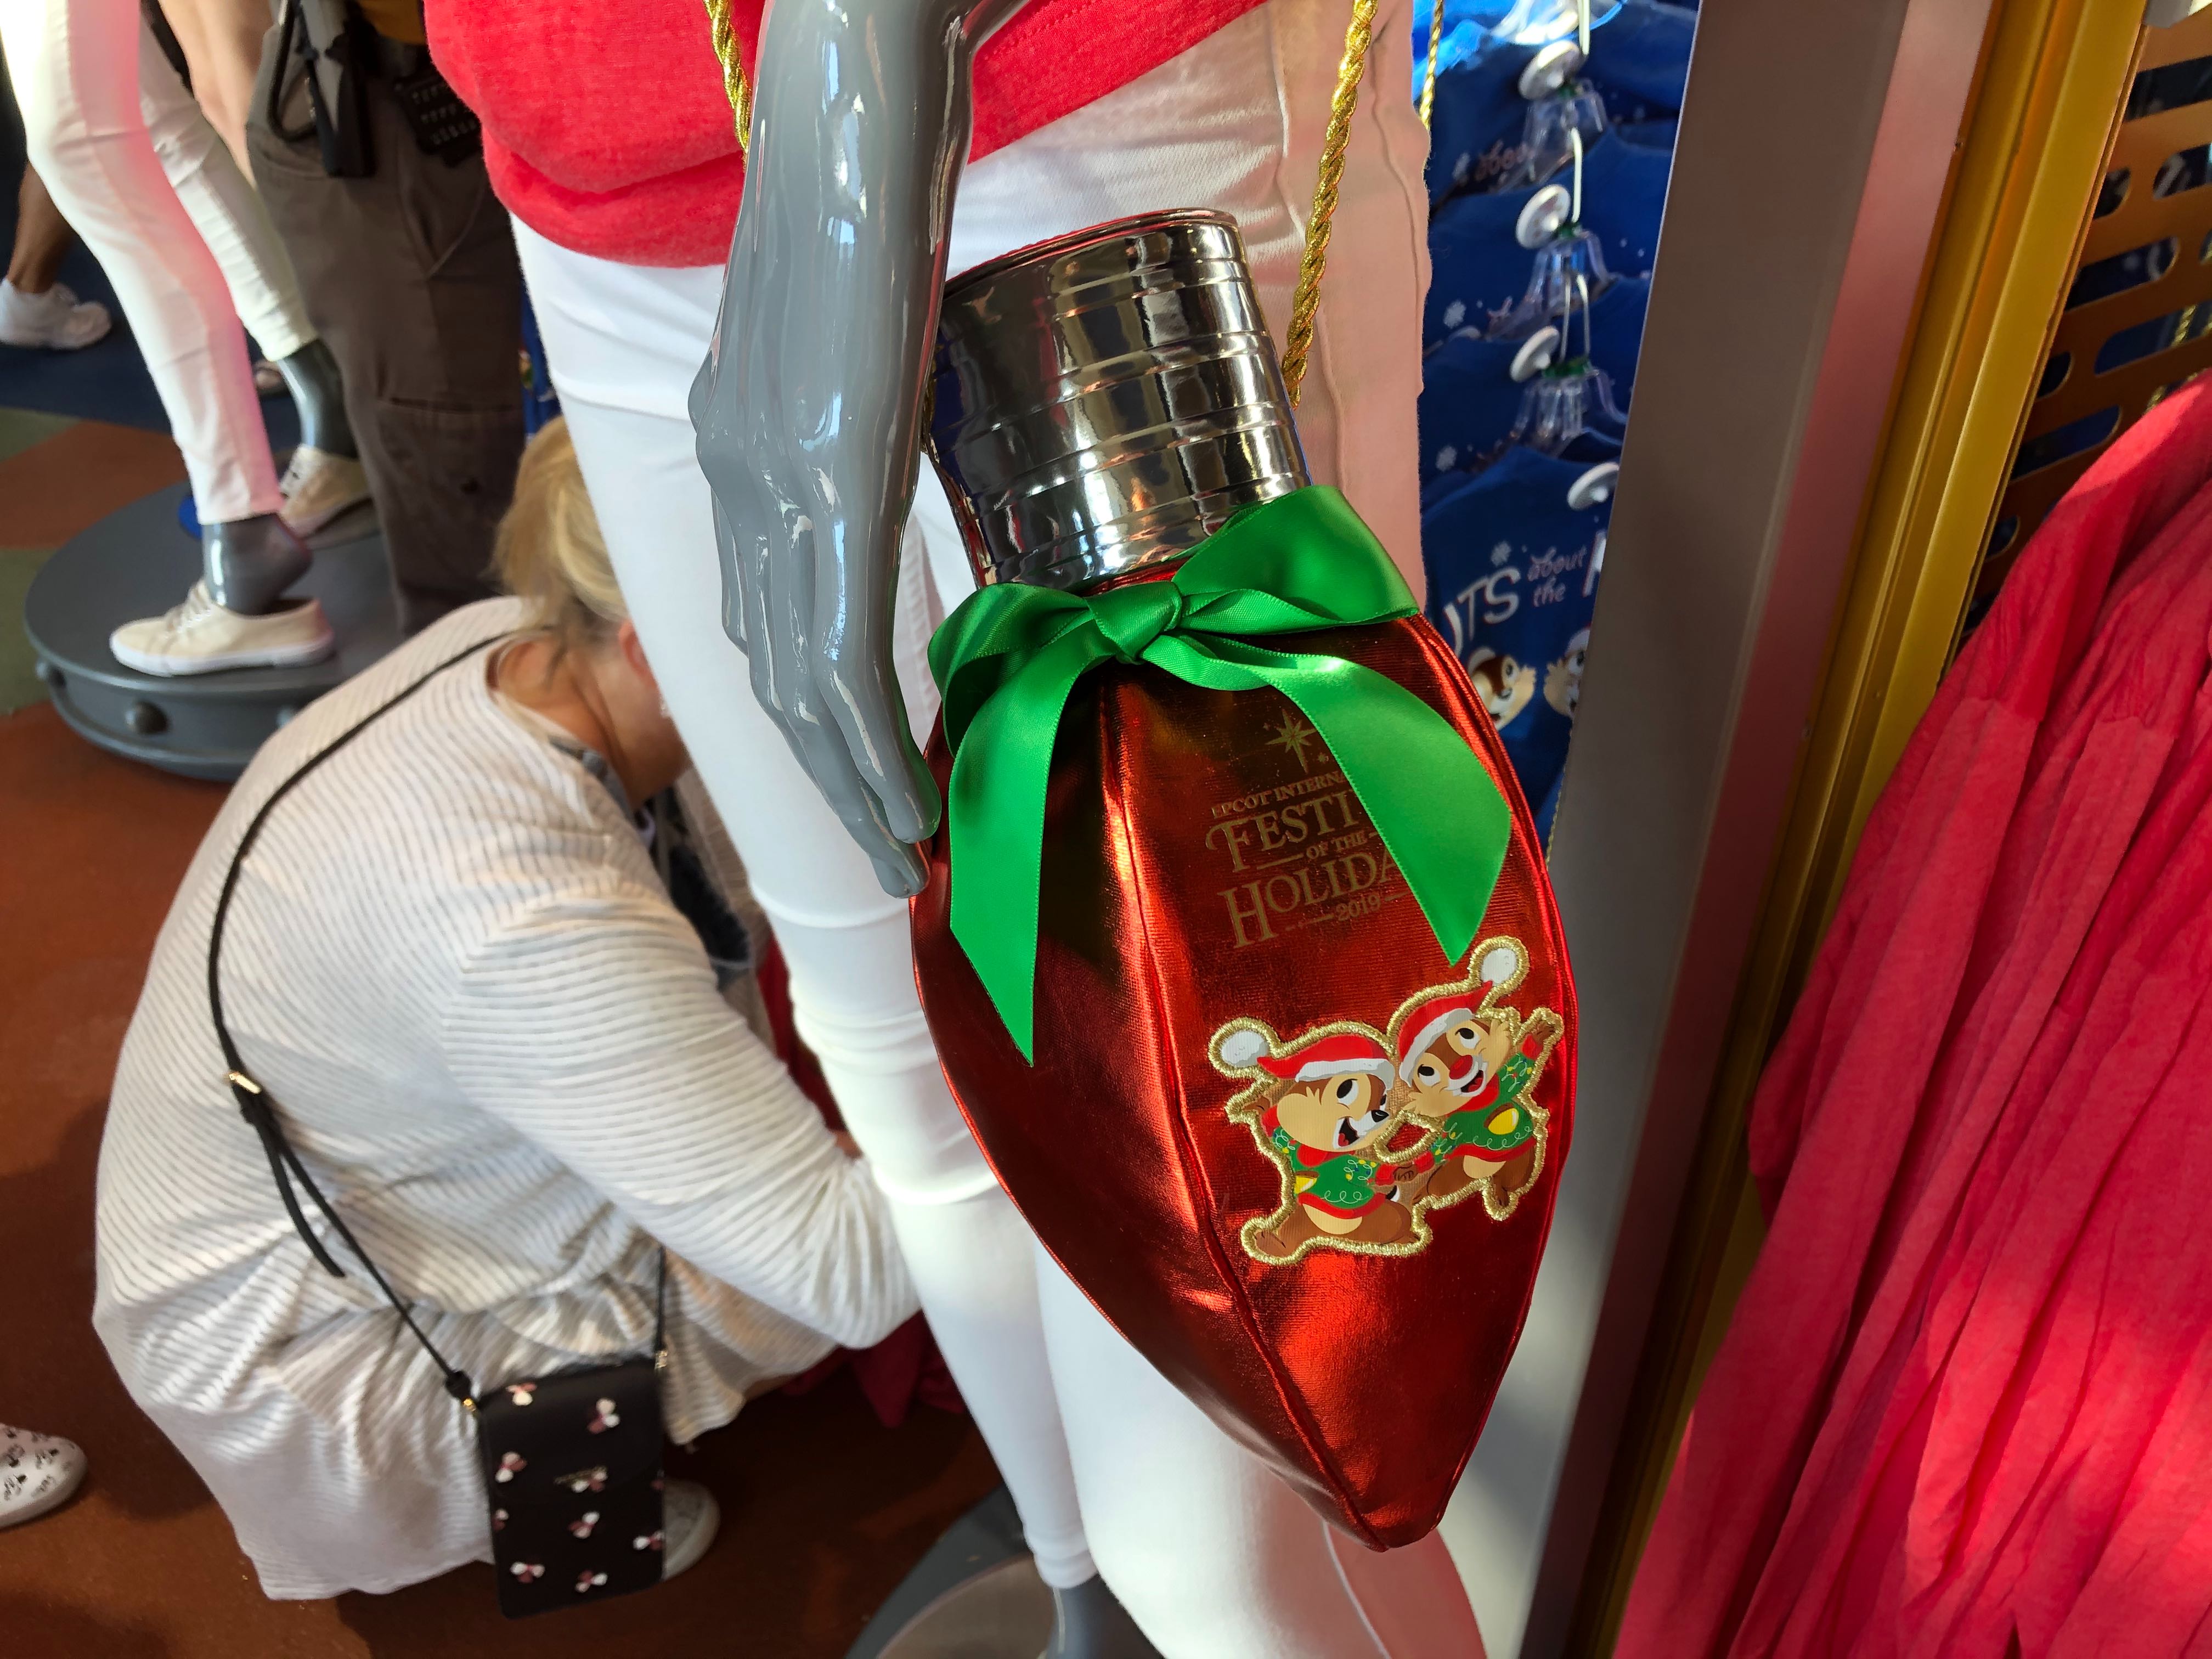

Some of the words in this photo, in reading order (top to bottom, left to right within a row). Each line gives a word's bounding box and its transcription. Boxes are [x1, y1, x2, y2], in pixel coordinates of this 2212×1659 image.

[1527, 545, 1588, 582] about
[1533, 575, 1566, 607] the
[1211, 790, 1272, 819] EPCOT
[1205, 788, 1361, 873] FESTI
[1306, 842, 1329, 860] OF
[1330, 830, 1368, 853] THE
[1335, 893, 1382, 921] 2019
